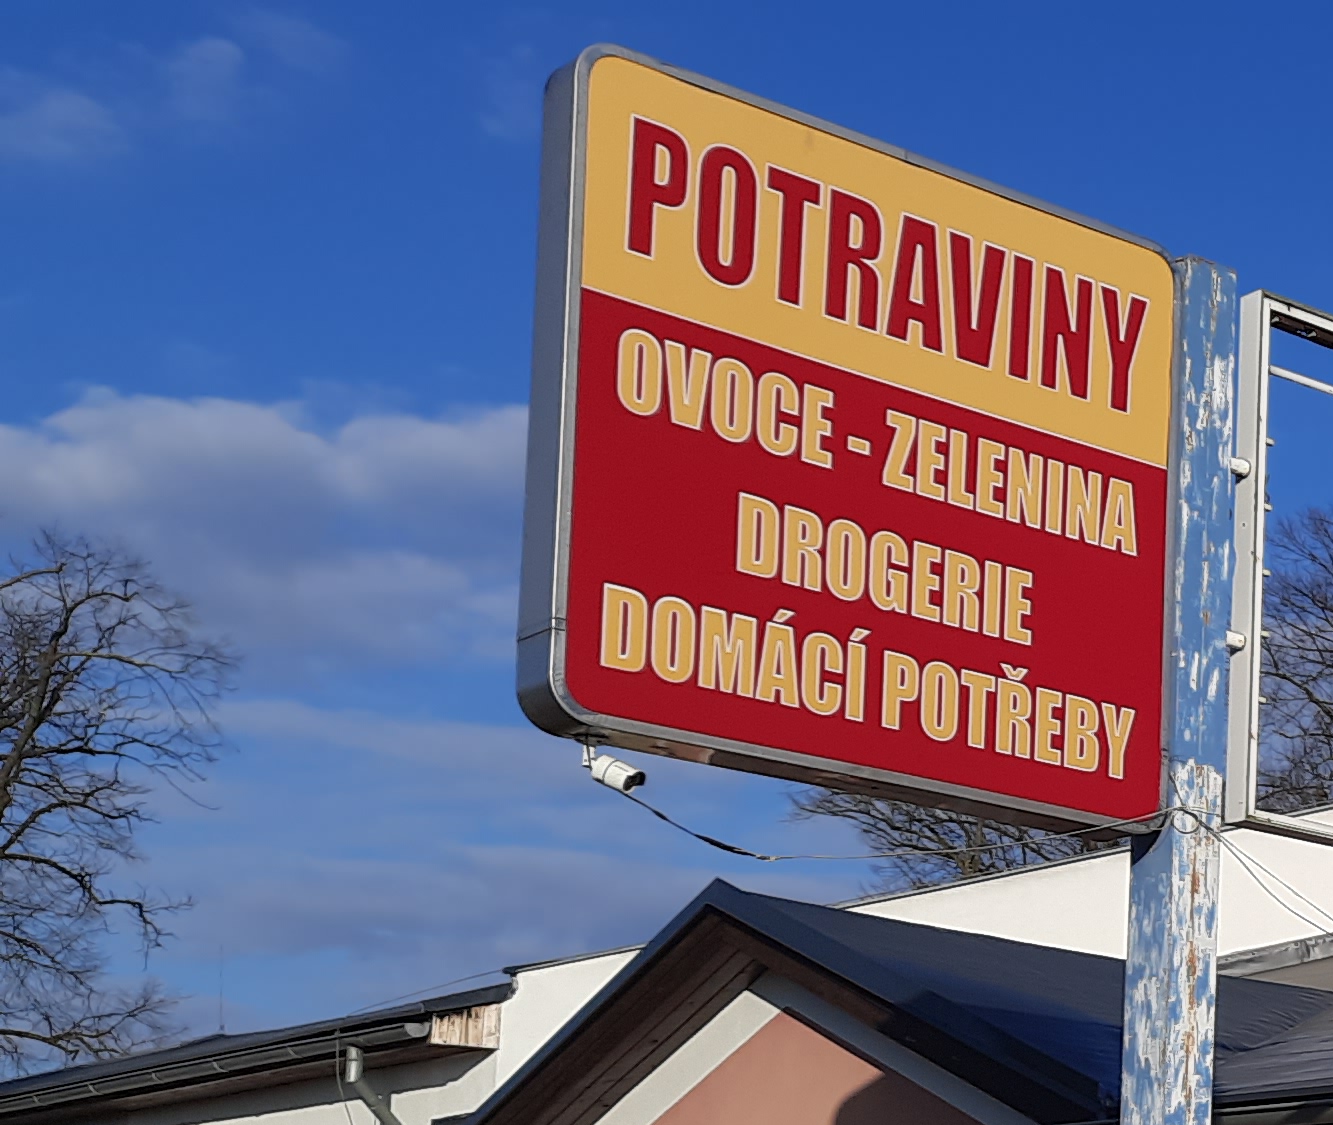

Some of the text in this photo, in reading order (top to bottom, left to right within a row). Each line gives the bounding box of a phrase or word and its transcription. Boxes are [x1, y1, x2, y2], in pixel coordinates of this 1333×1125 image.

[623, 113, 1151, 415] POTRAVINY
[616, 327, 1139, 557] OVOCE - ZELENINA
[734, 490, 1034, 646] DROGERIE
[599, 582, 1136, 780] DOMÁCÍ POTŘEBY
